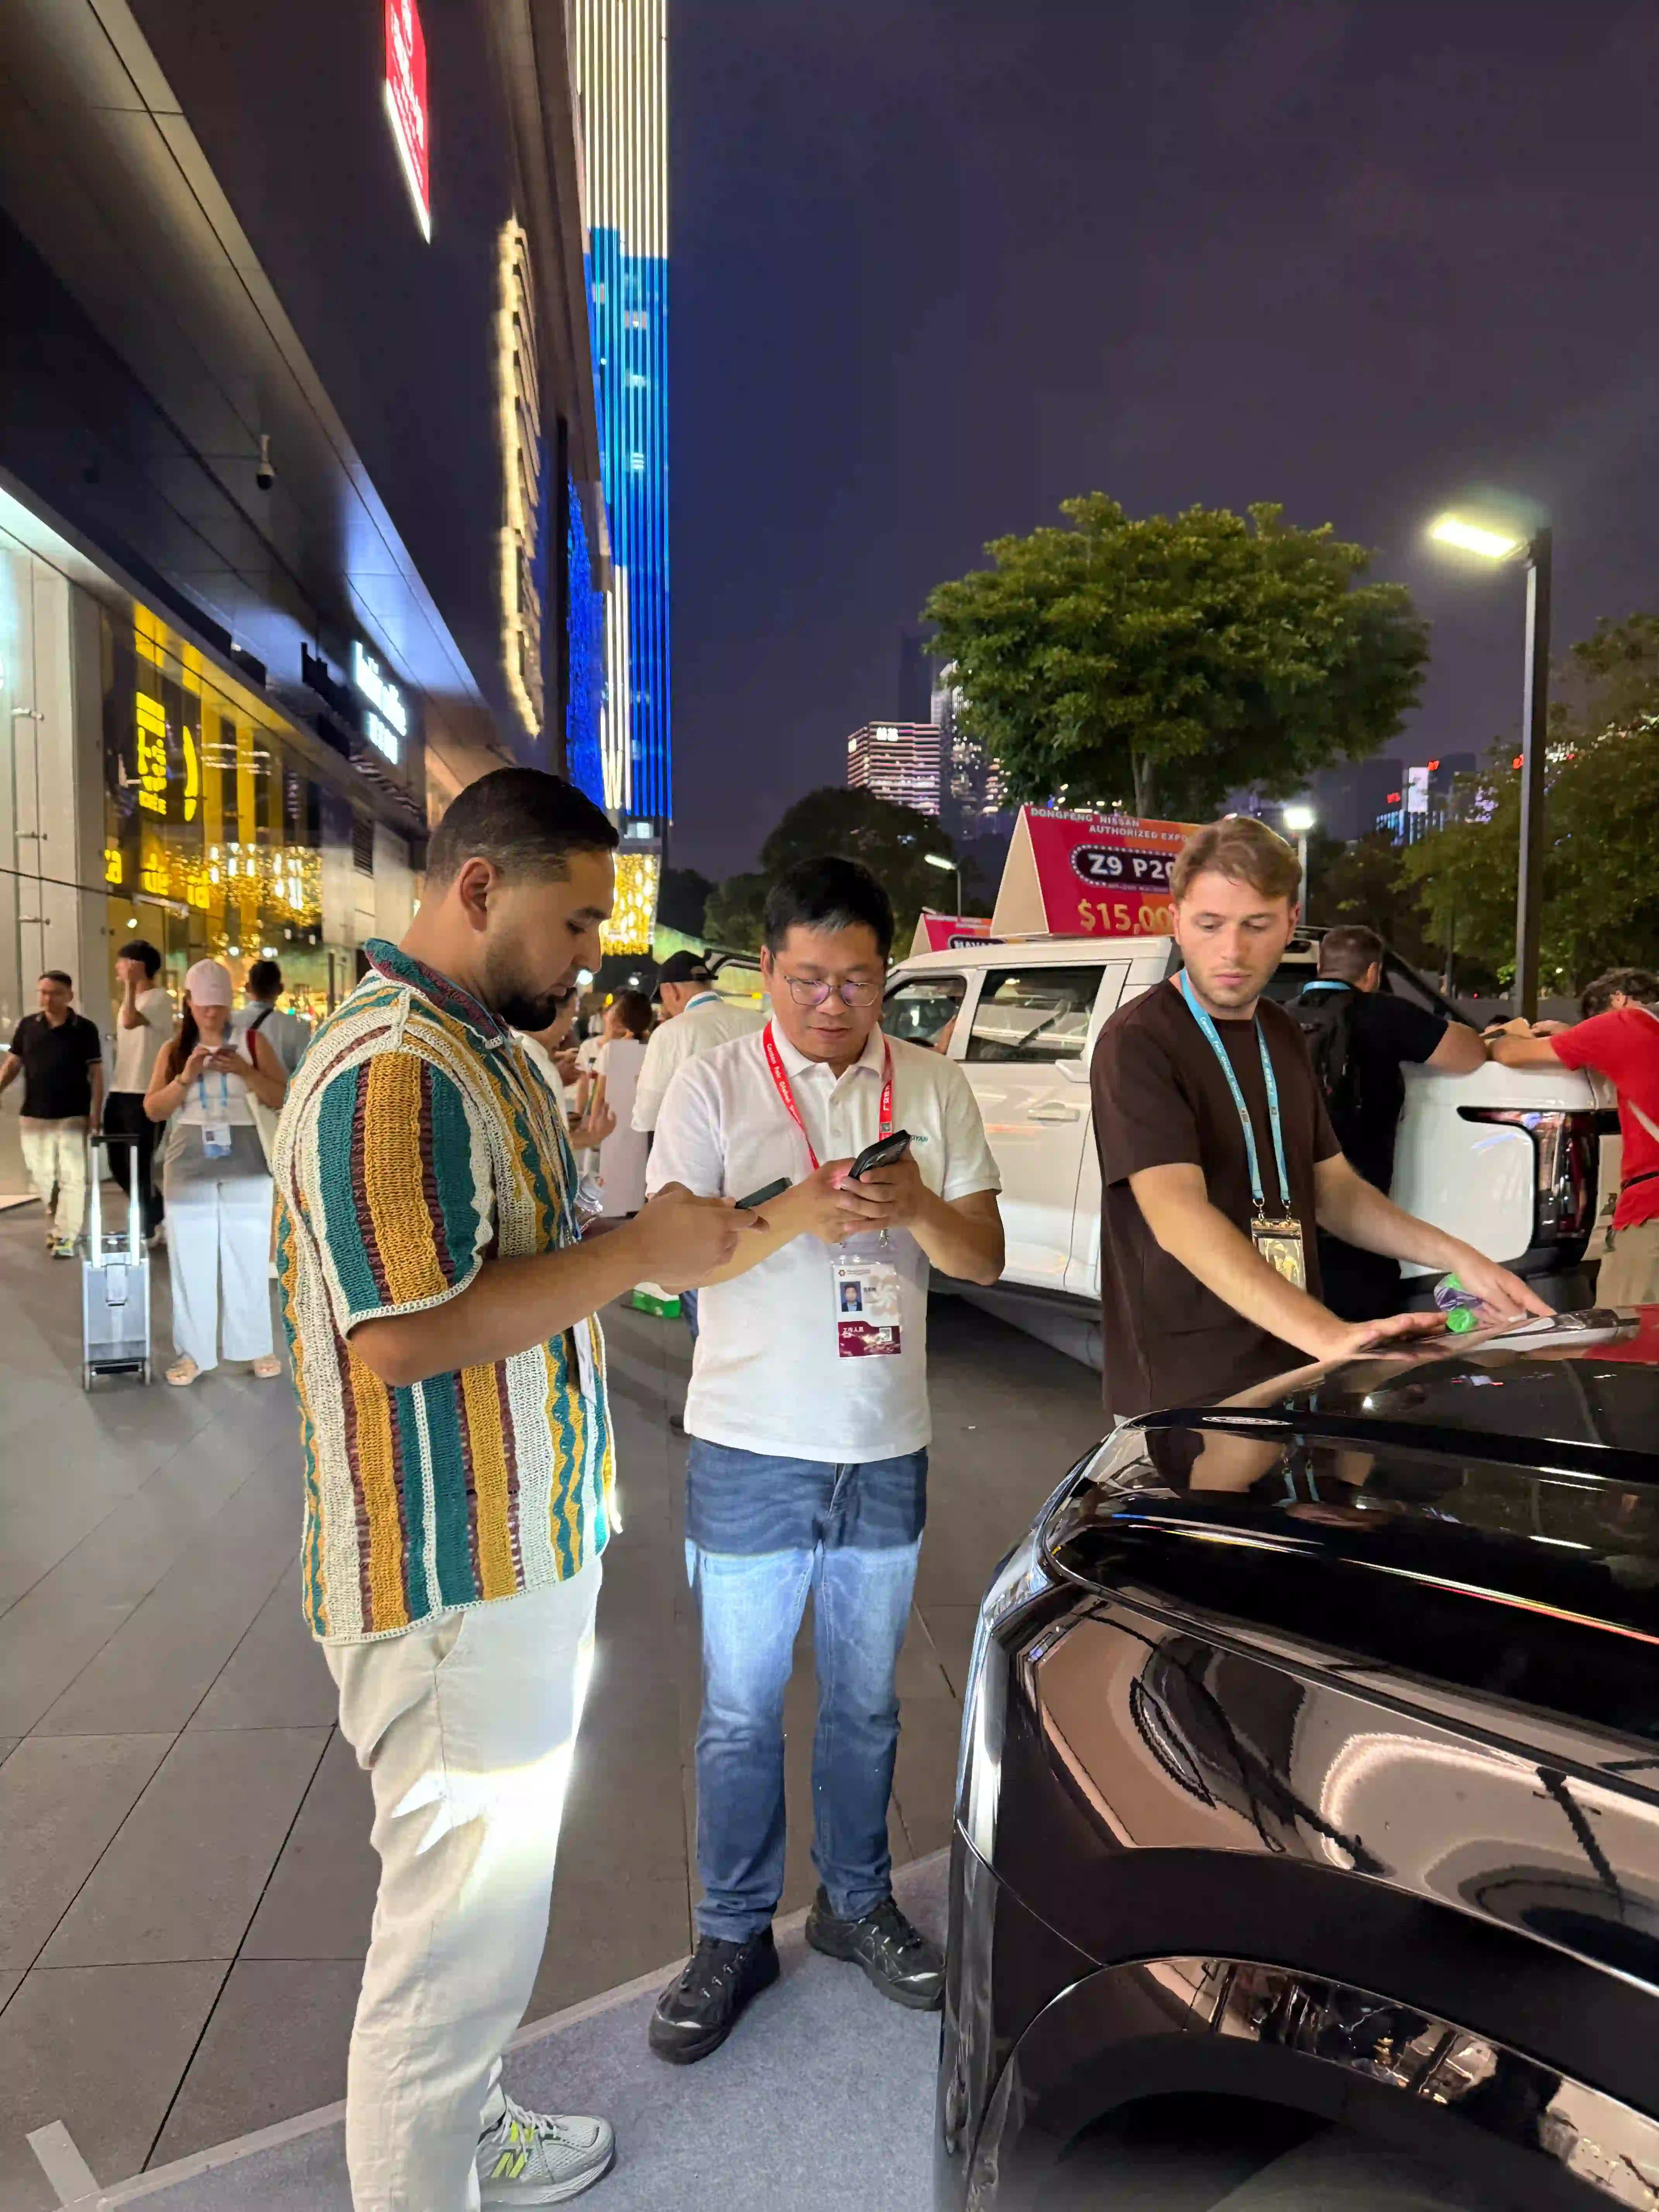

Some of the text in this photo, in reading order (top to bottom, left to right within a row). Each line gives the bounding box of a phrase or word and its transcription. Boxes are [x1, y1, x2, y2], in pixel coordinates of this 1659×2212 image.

[1030, 808, 1139, 827] DONGFENG NISSAN
[1089, 825, 1188, 842] AUTHORIZED EXPO
[1087, 853, 1176, 879] Z9 P20
[1077, 898, 1174, 935] $15,00
